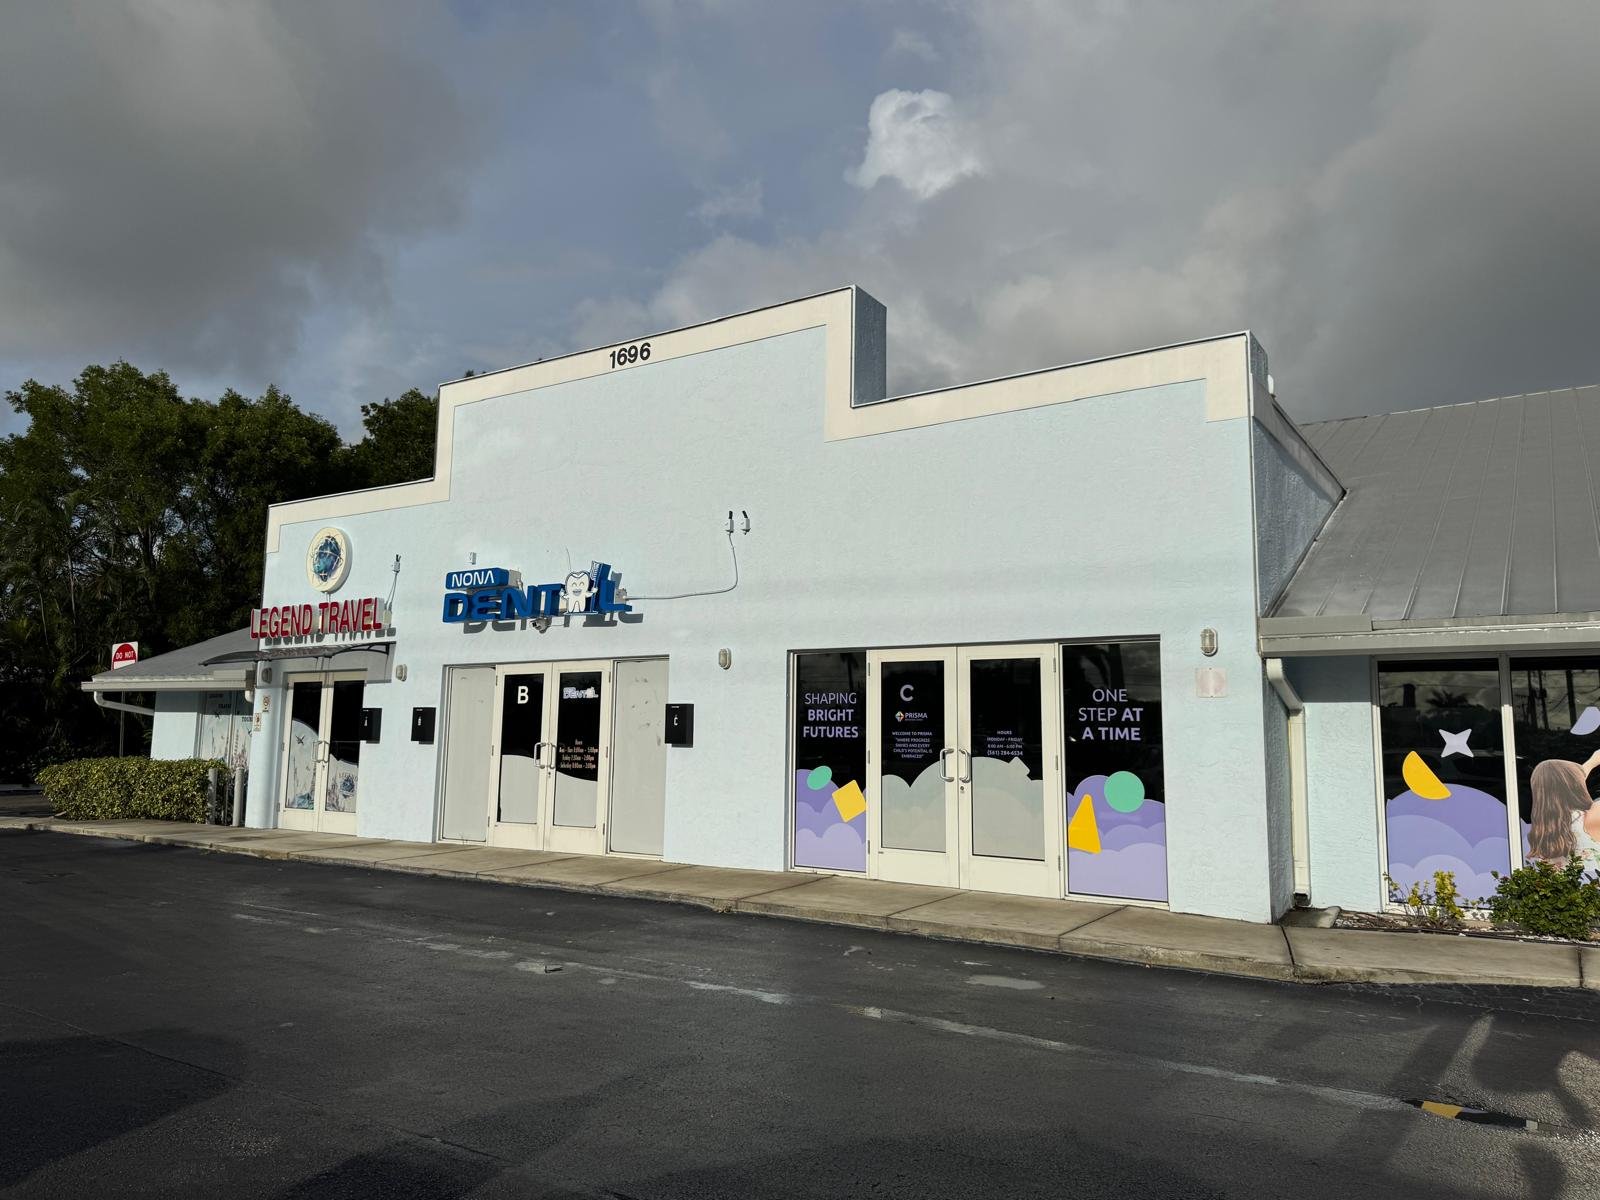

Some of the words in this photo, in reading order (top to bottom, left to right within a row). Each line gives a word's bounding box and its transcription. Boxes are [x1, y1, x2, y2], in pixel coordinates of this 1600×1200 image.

[610, 342, 651, 369] 1696
[451, 570, 495, 588] NONA
[443, 562, 632, 623] DENTL
[250, 604, 313, 639] LEGEND
[319, 597, 383, 634] TRAVEL
[116, 652, 123, 660] DO
[124, 650, 134, 659] NOT
[517, 685, 529, 704] B
[804, 692, 857, 705] SHAPING
[900, 684, 914, 702] C
[1092, 688, 1128, 702] ONE
[808, 709, 854, 721] BRIGHT
[1078, 707, 1117, 722] STEP
[1121, 707, 1144, 722] AT
[803, 726, 859, 738] FUTURES
[1081, 726, 1095, 740] A
[1097, 727, 1141, 741] TIME
